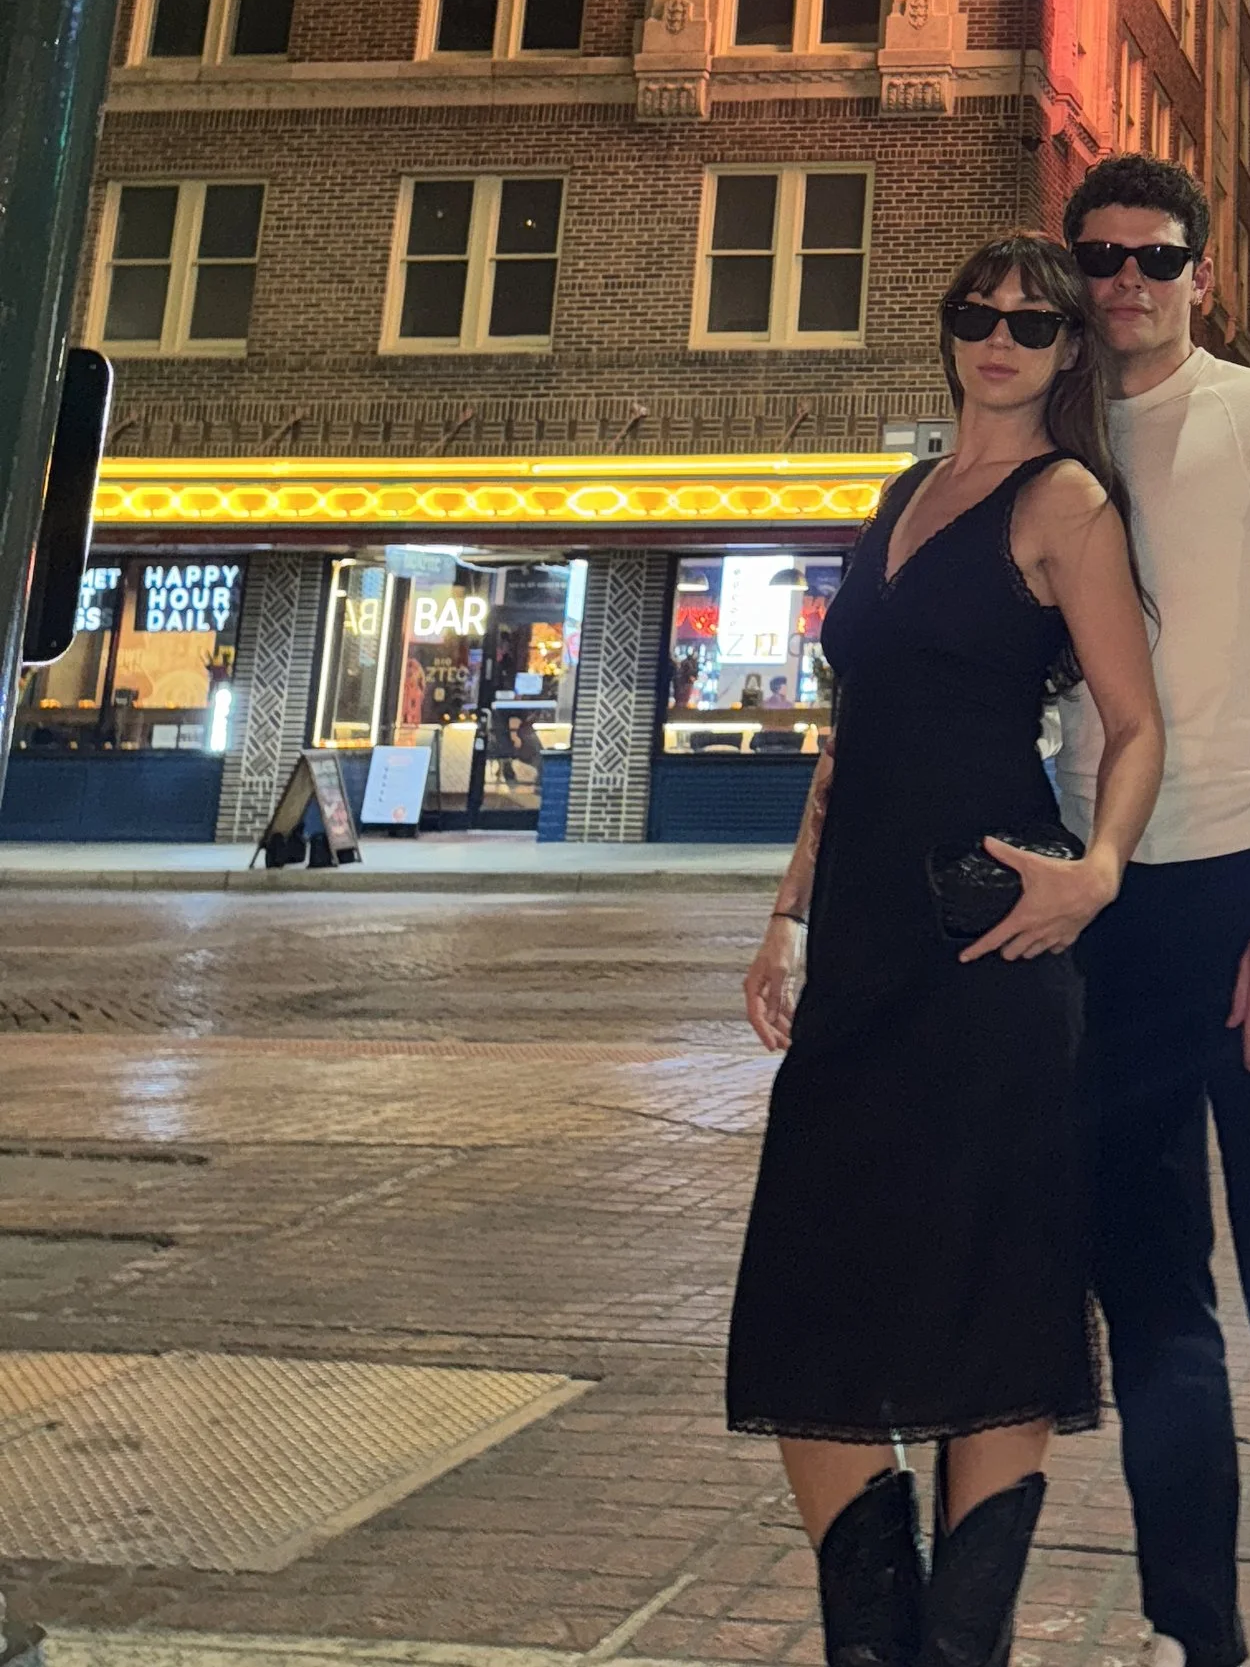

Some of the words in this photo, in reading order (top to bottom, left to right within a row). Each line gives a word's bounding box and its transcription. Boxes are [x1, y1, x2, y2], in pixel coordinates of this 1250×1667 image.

[144, 565, 239, 588] HAPPY
[148, 587, 230, 610] HOUR
[146, 609, 230, 631] DAILY
[413, 596, 488, 636] BAR
